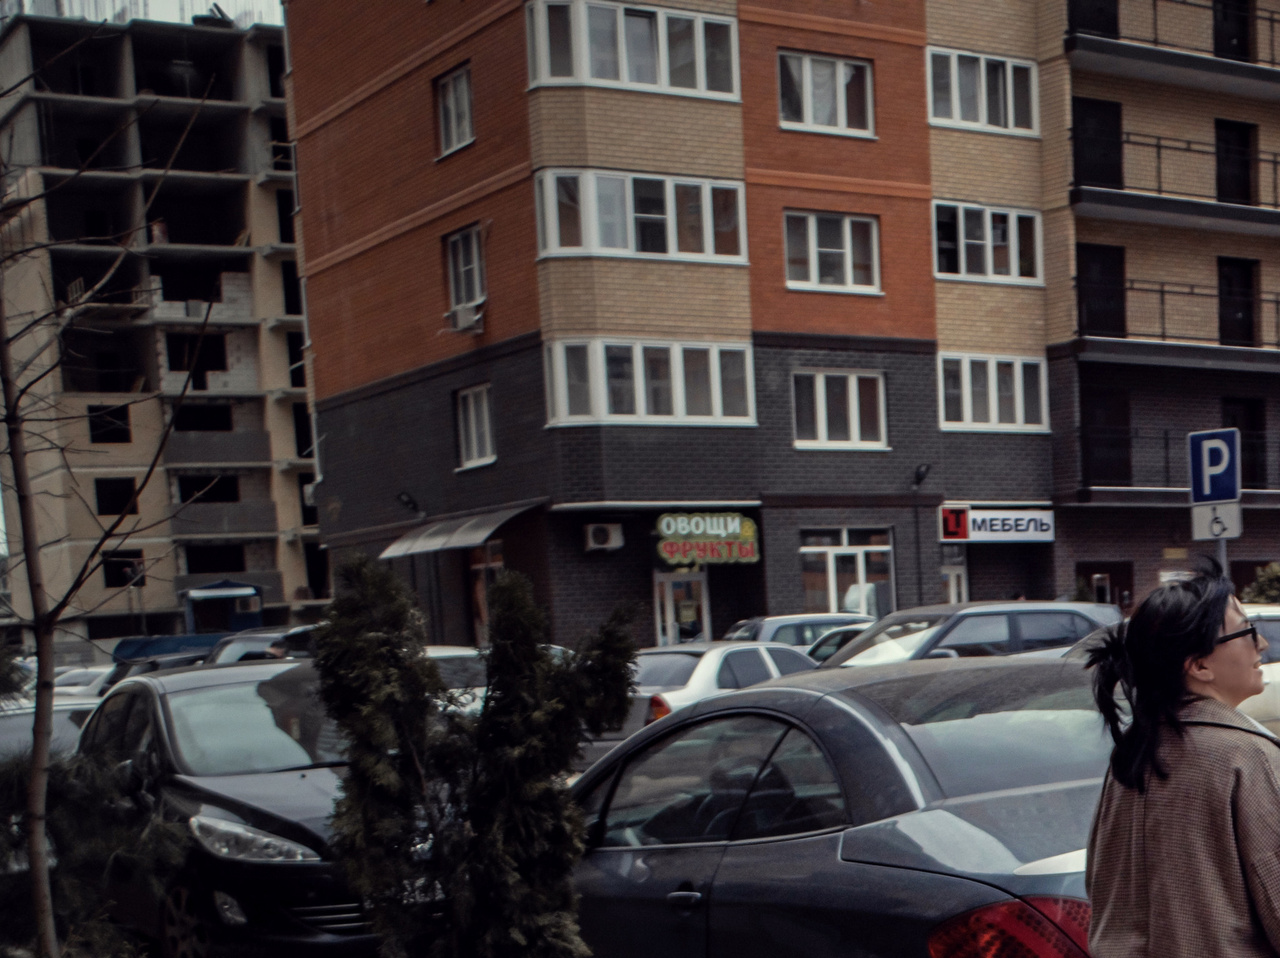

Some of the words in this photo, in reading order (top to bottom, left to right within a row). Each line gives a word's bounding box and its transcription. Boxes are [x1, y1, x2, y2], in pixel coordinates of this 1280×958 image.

[1202, 438, 1230, 496] P
[661, 516, 740, 537] ОВОЩИ
[971, 517, 1051, 532] МЕБЕЛЬ
[662, 540, 755, 558] ФРУКТЫ
